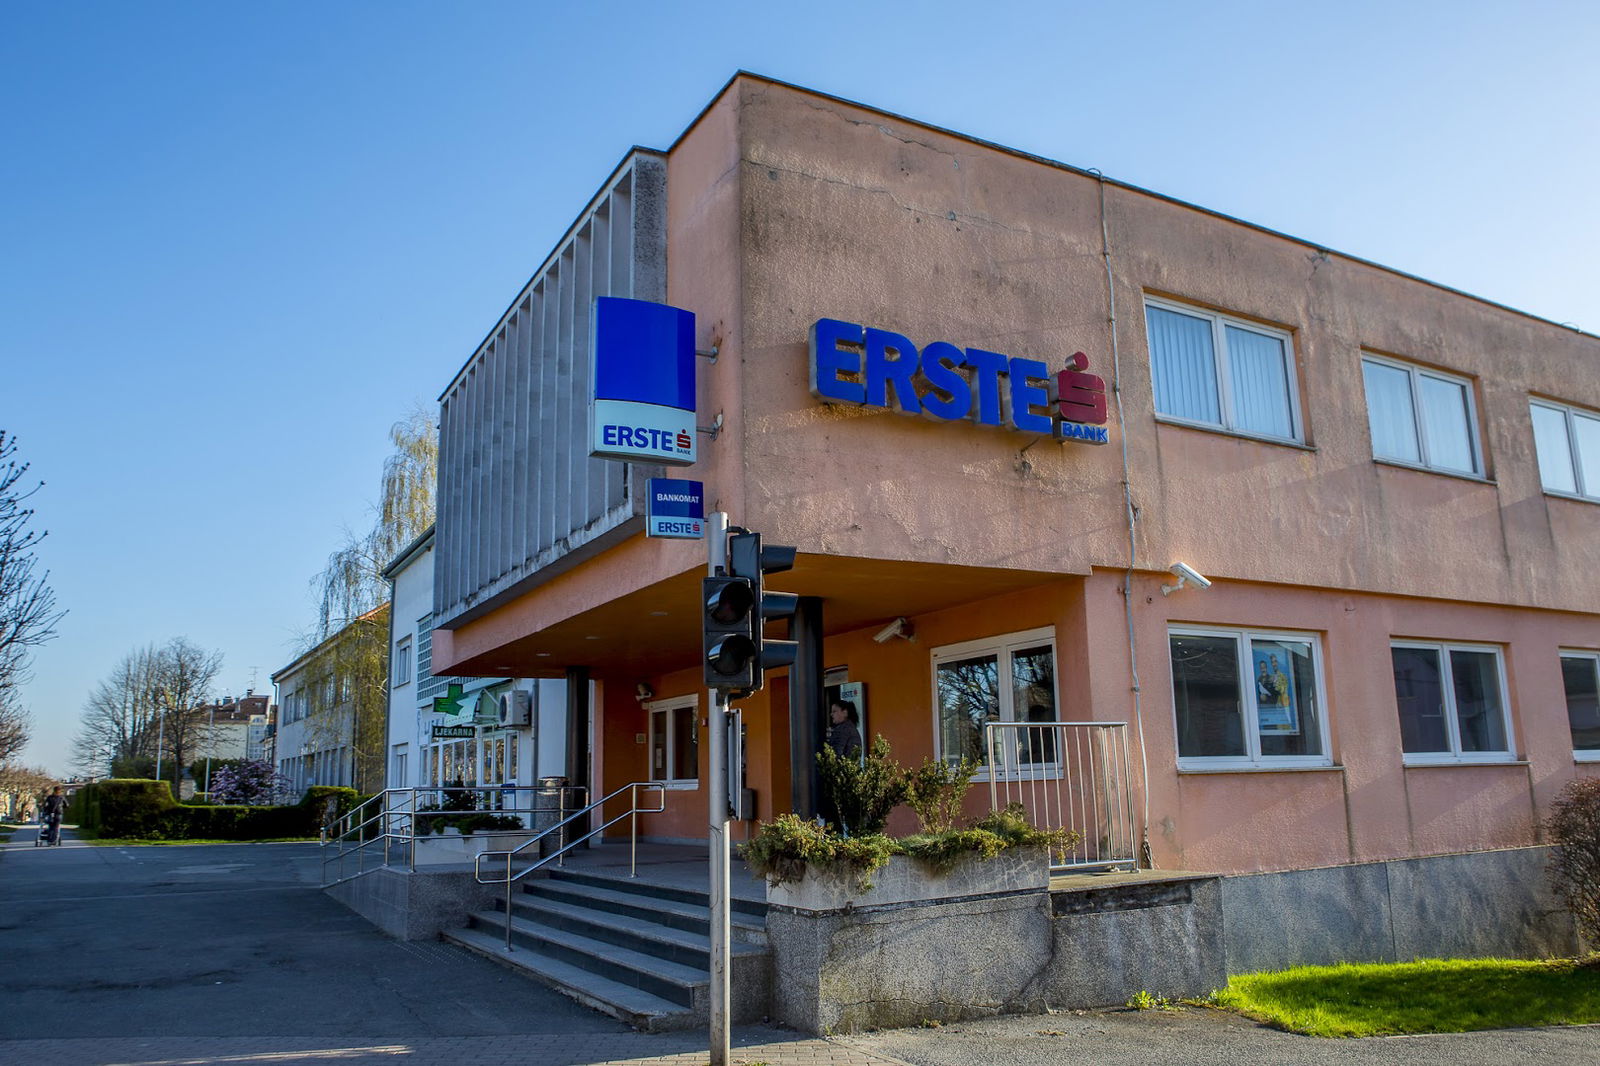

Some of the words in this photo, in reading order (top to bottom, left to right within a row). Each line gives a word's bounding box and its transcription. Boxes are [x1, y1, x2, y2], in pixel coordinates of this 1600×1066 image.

[810, 318, 1052, 433] ERSTE
[603, 425, 673, 451] ERSTE
[1062, 422, 1107, 441] BANK
[657, 493, 699, 503] BANKOMAT
[658, 521, 691, 533] ERSTE
[435, 727, 473, 736] LJEKARNA
